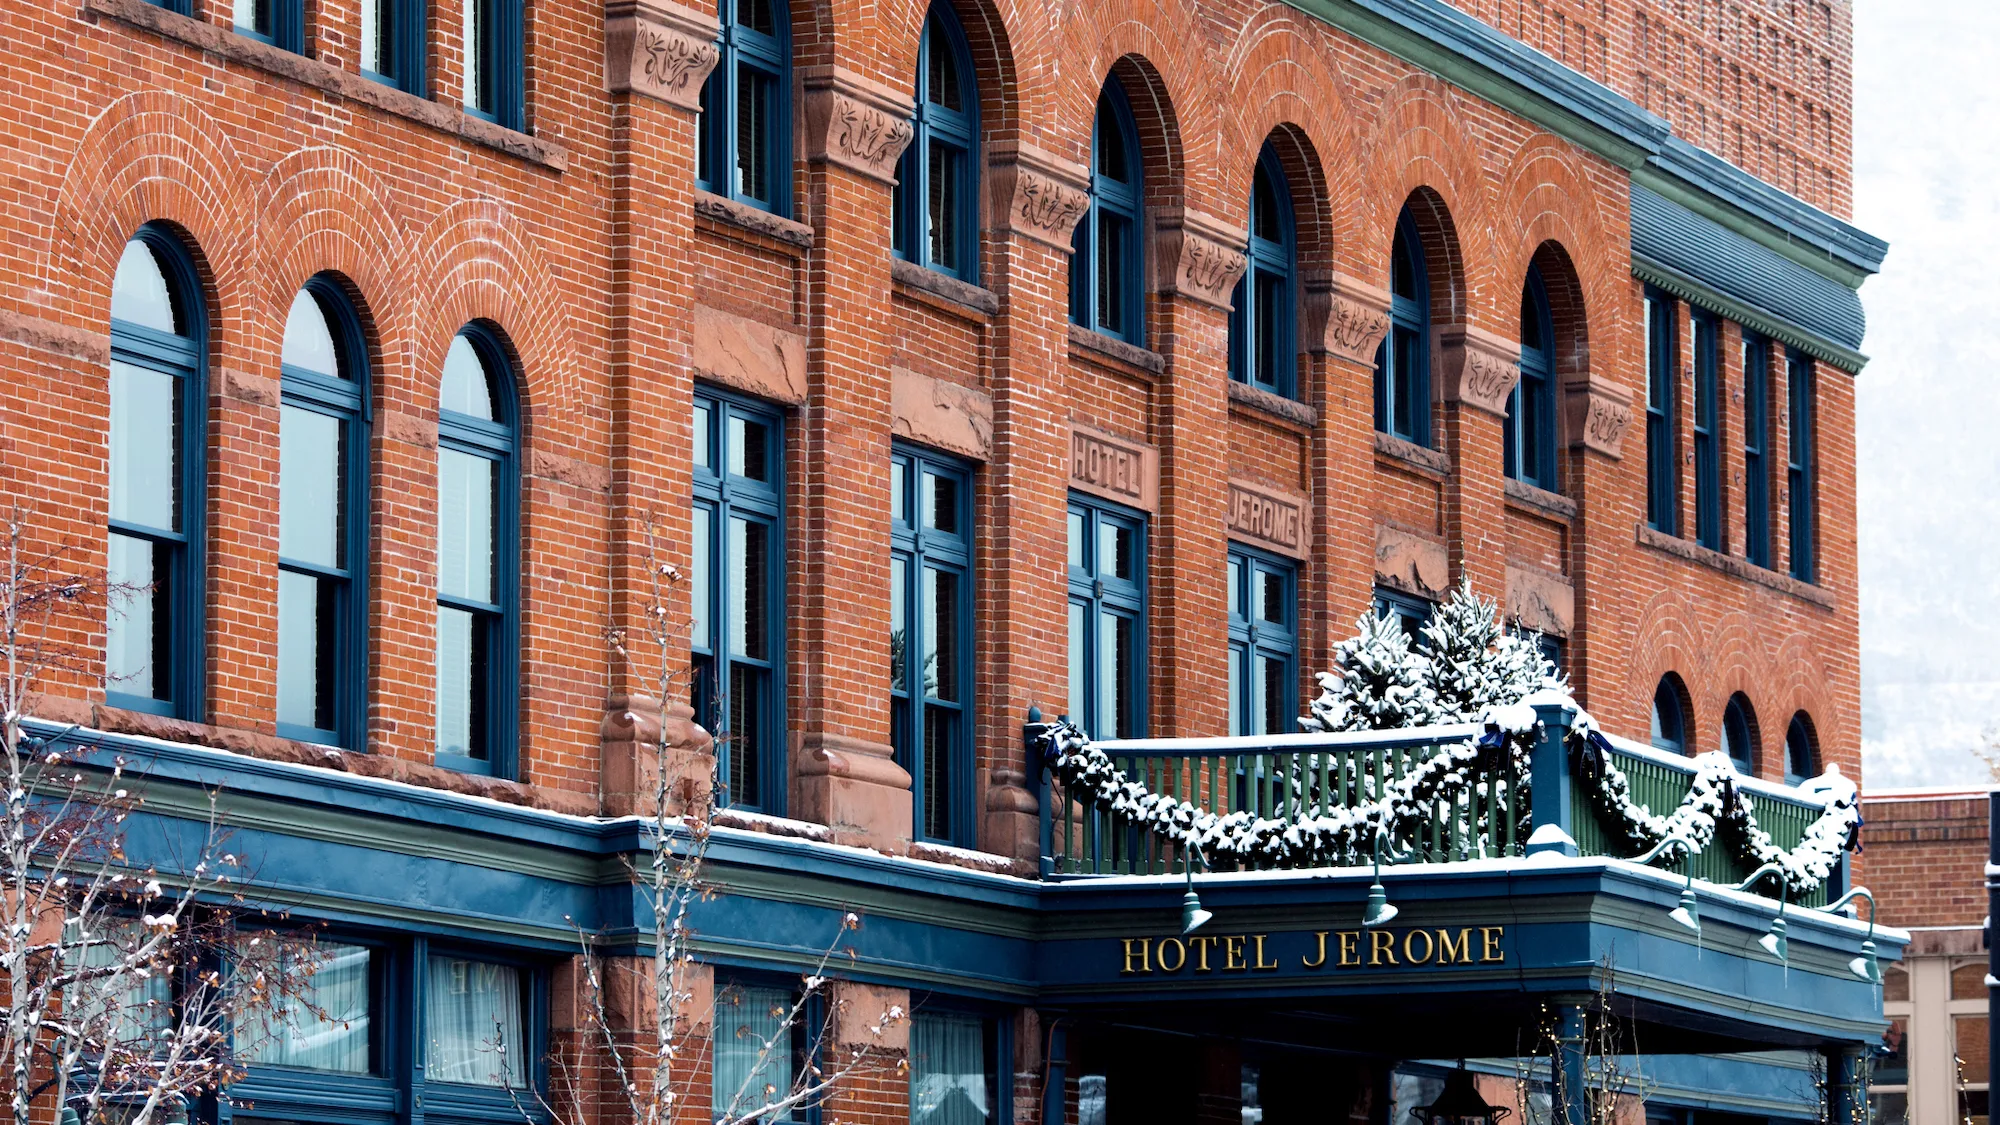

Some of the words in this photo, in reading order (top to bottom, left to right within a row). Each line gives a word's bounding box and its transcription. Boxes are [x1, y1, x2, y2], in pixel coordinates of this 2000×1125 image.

[1073, 436, 1140, 494] HOTEL
[1227, 489, 1298, 546] JEROME
[1119, 934, 1278, 973] HOTEL
[1302, 926, 1505, 967] JEROME
